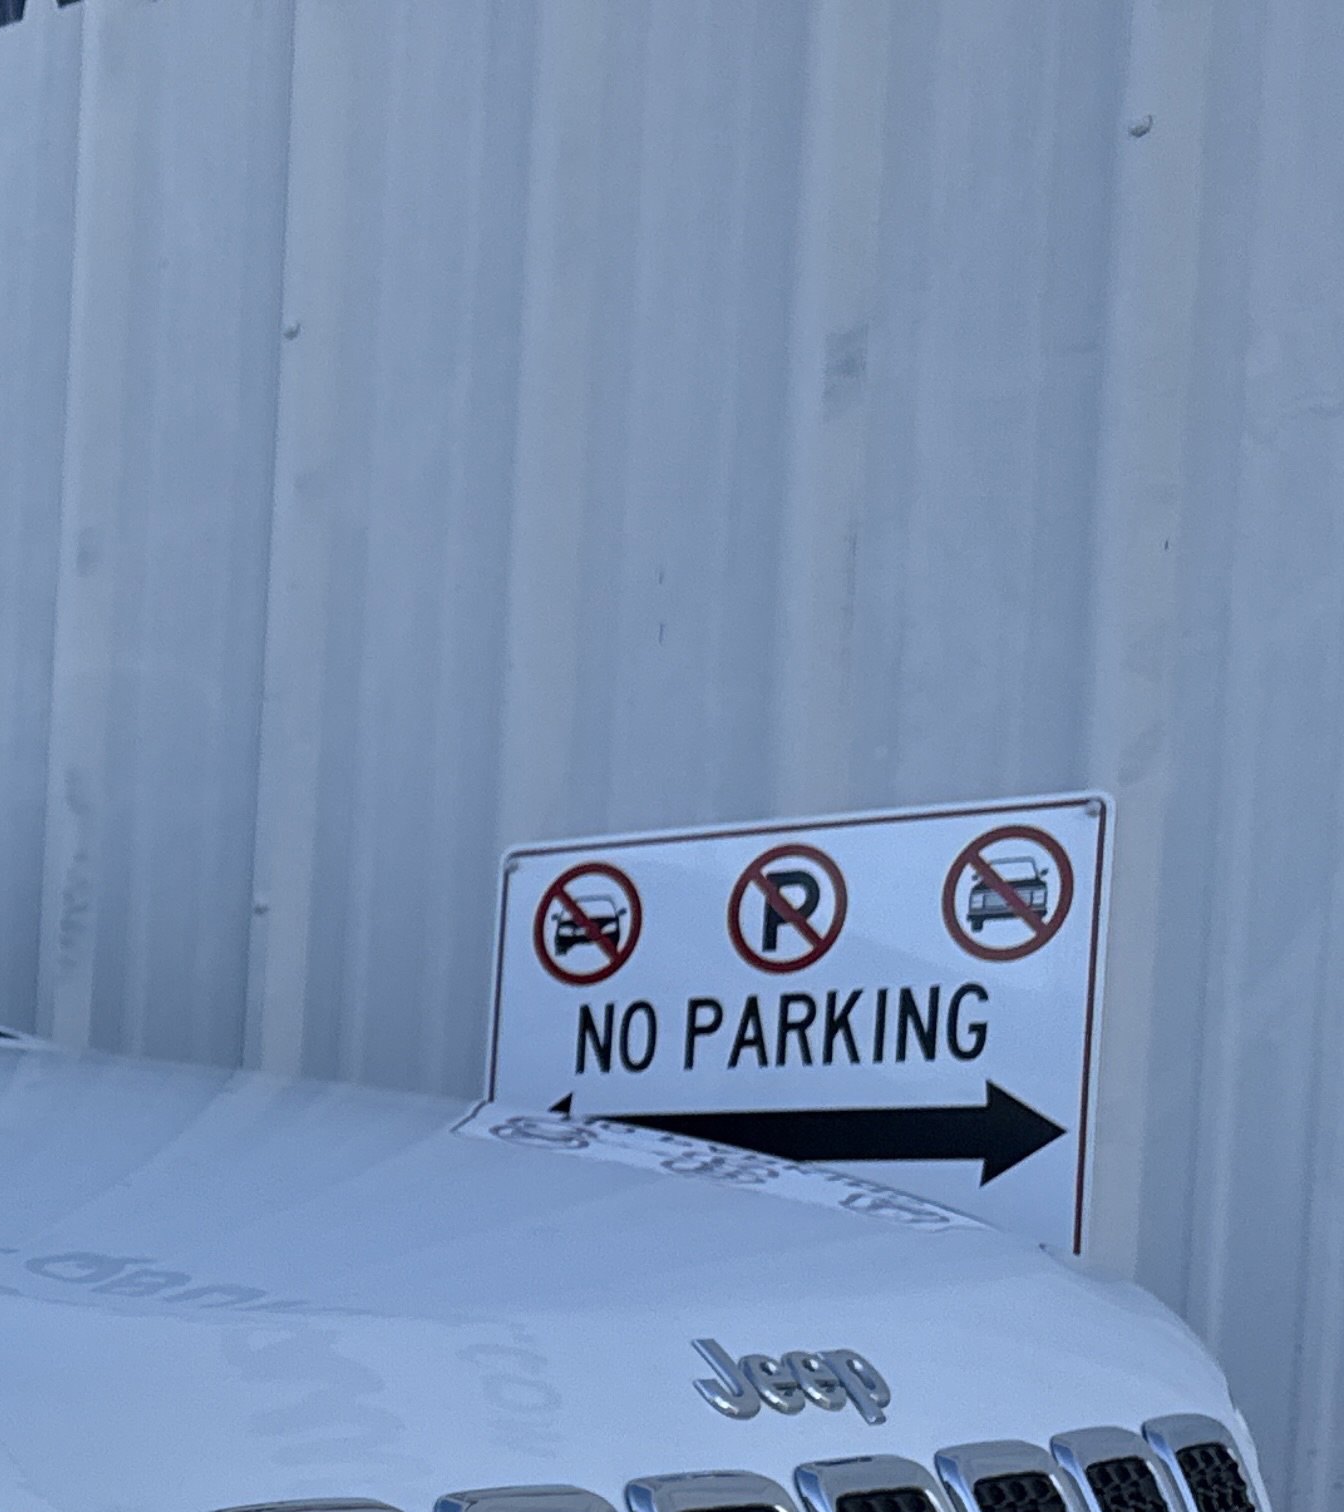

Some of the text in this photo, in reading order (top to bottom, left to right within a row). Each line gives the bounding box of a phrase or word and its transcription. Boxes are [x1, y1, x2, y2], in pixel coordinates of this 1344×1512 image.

[575, 983, 990, 1075] NO PARKING
[691, 1338, 891, 1426] Jeep
